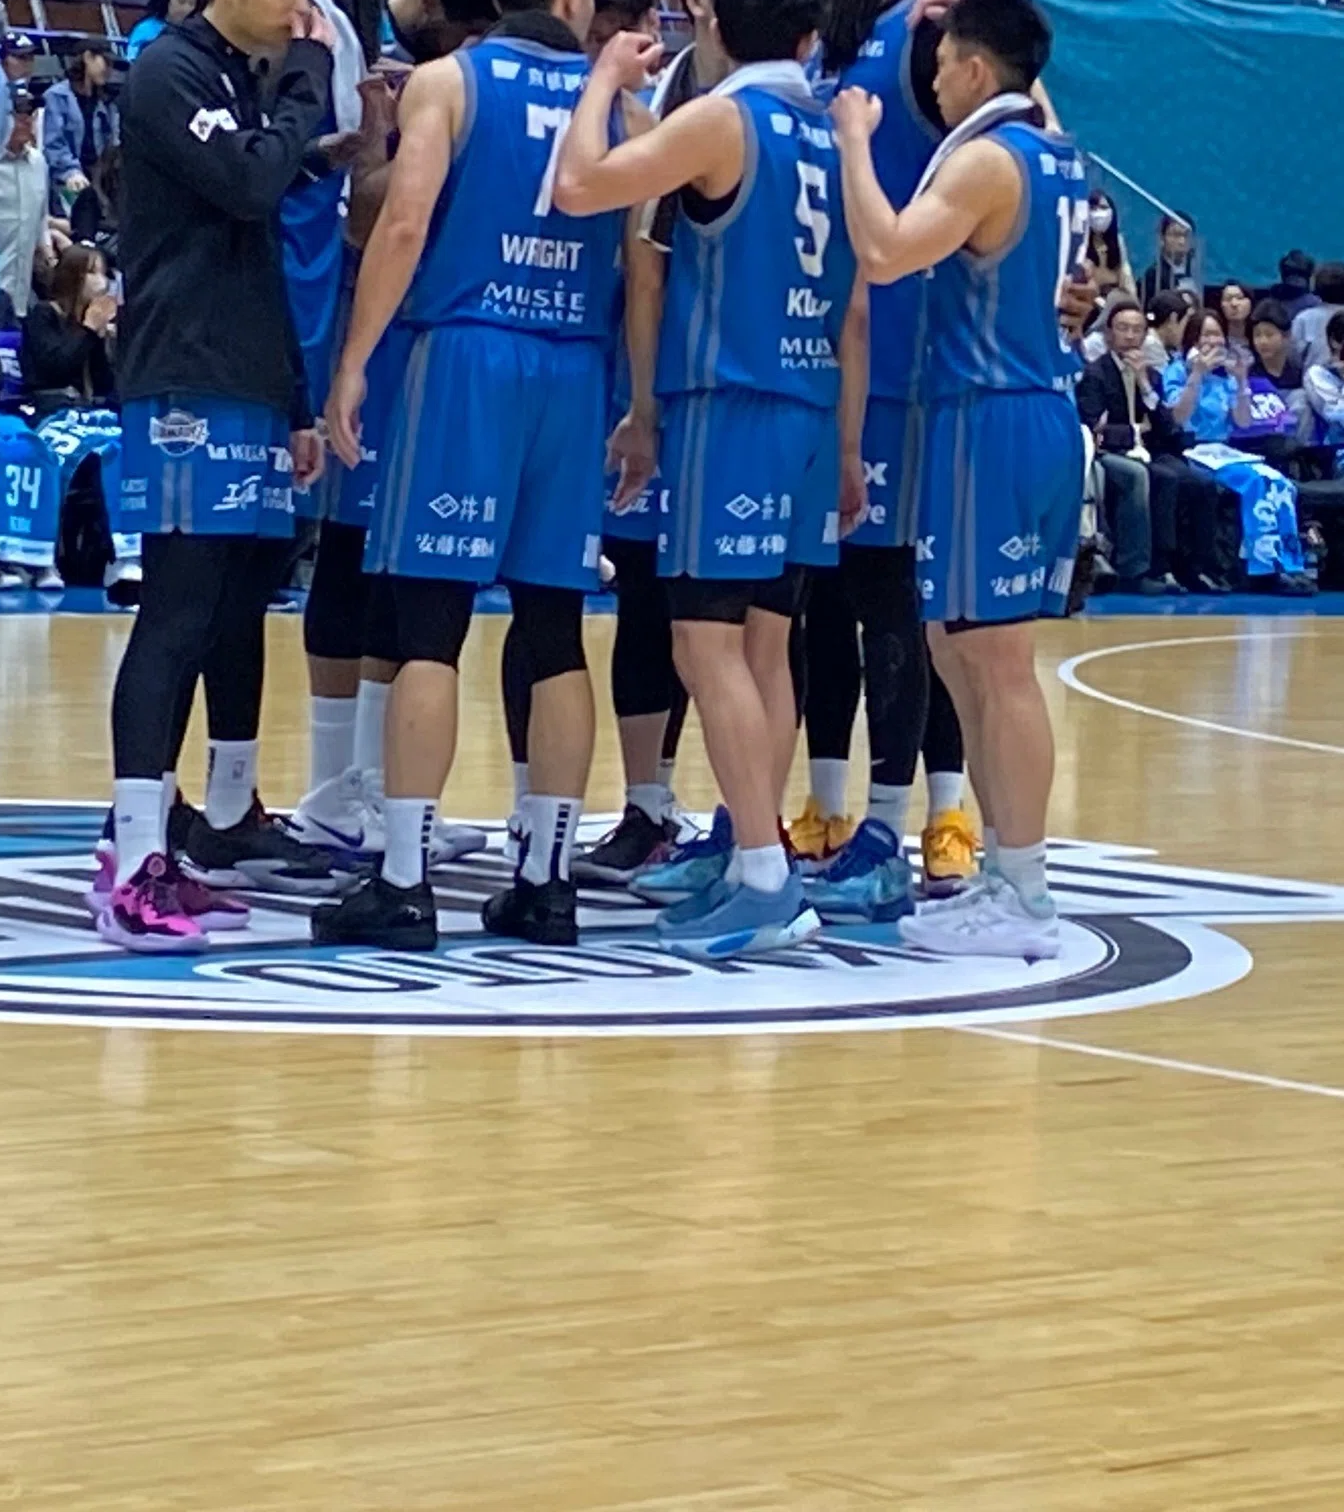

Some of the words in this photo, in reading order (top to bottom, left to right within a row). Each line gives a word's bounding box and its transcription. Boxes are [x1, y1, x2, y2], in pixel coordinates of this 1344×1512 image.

[526, 102, 572, 217] 7
[794, 160, 831, 278] 5
[779, 336, 833, 356] MUS
[5, 464, 42, 510] 34
